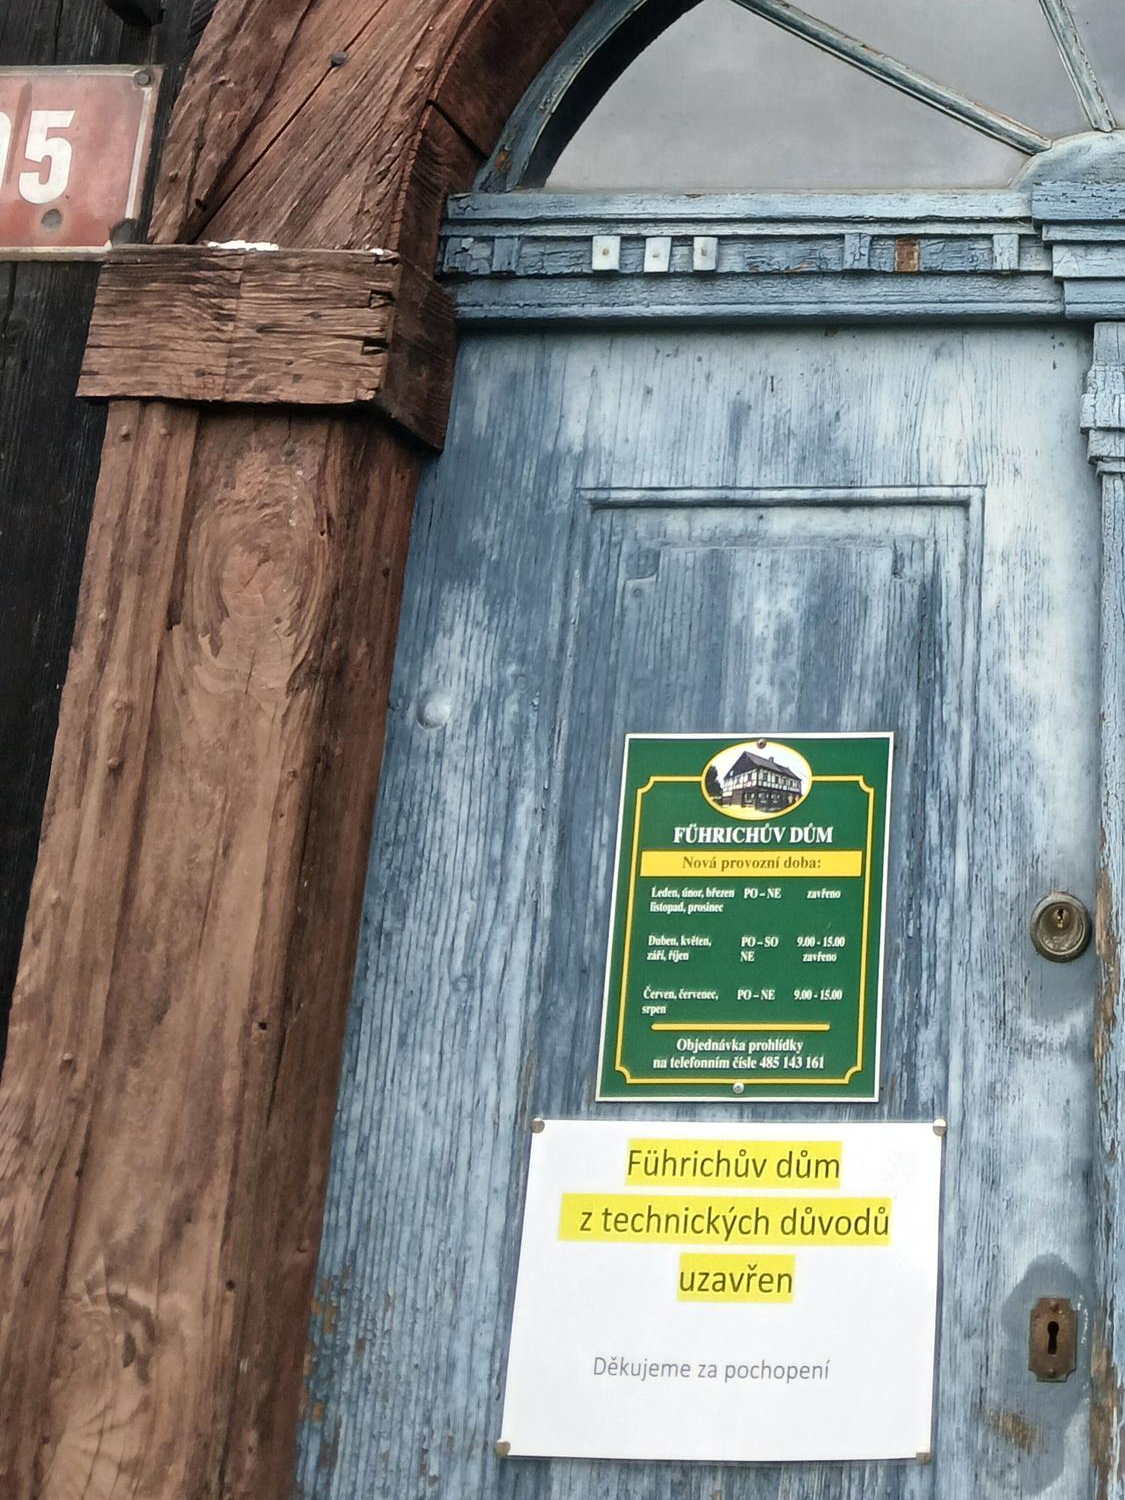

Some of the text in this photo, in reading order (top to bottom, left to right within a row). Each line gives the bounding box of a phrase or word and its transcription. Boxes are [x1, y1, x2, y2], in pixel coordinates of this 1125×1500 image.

[0, 109, 76, 204] 5
[673, 822, 834, 844] FÜHRICHŮV DŮM
[682, 855, 821, 872] Nová provozní doba:
[676, 1038, 804, 1055] Objednávka prohlídky
[652, 1055, 824, 1069] na telefonním čísle 485 143 161
[627, 1148, 840, 1179] Führichův dům
[579, 1204, 889, 1242] z technických důvodů
[679, 1264, 793, 1294] uzavřen
[593, 1356, 831, 1384] Děkujeme za pochopení
